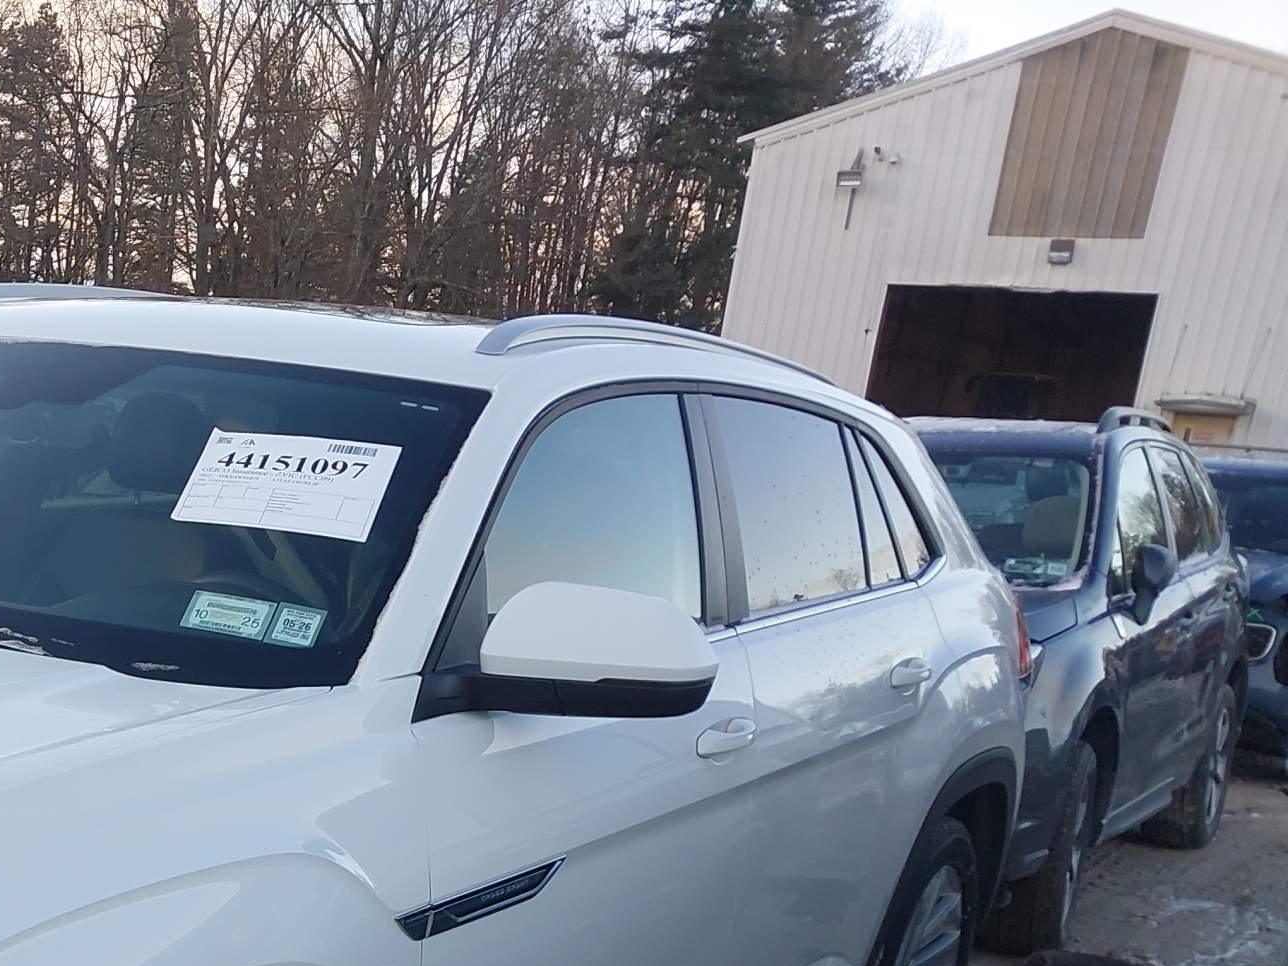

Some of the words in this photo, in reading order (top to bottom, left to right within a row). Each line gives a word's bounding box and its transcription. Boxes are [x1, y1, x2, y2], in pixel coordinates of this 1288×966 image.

[216, 451, 370, 480] 44151097
[231, 468, 269, 476] Insurance
[193, 608, 209, 620] 10
[241, 616, 261, 629] 25
